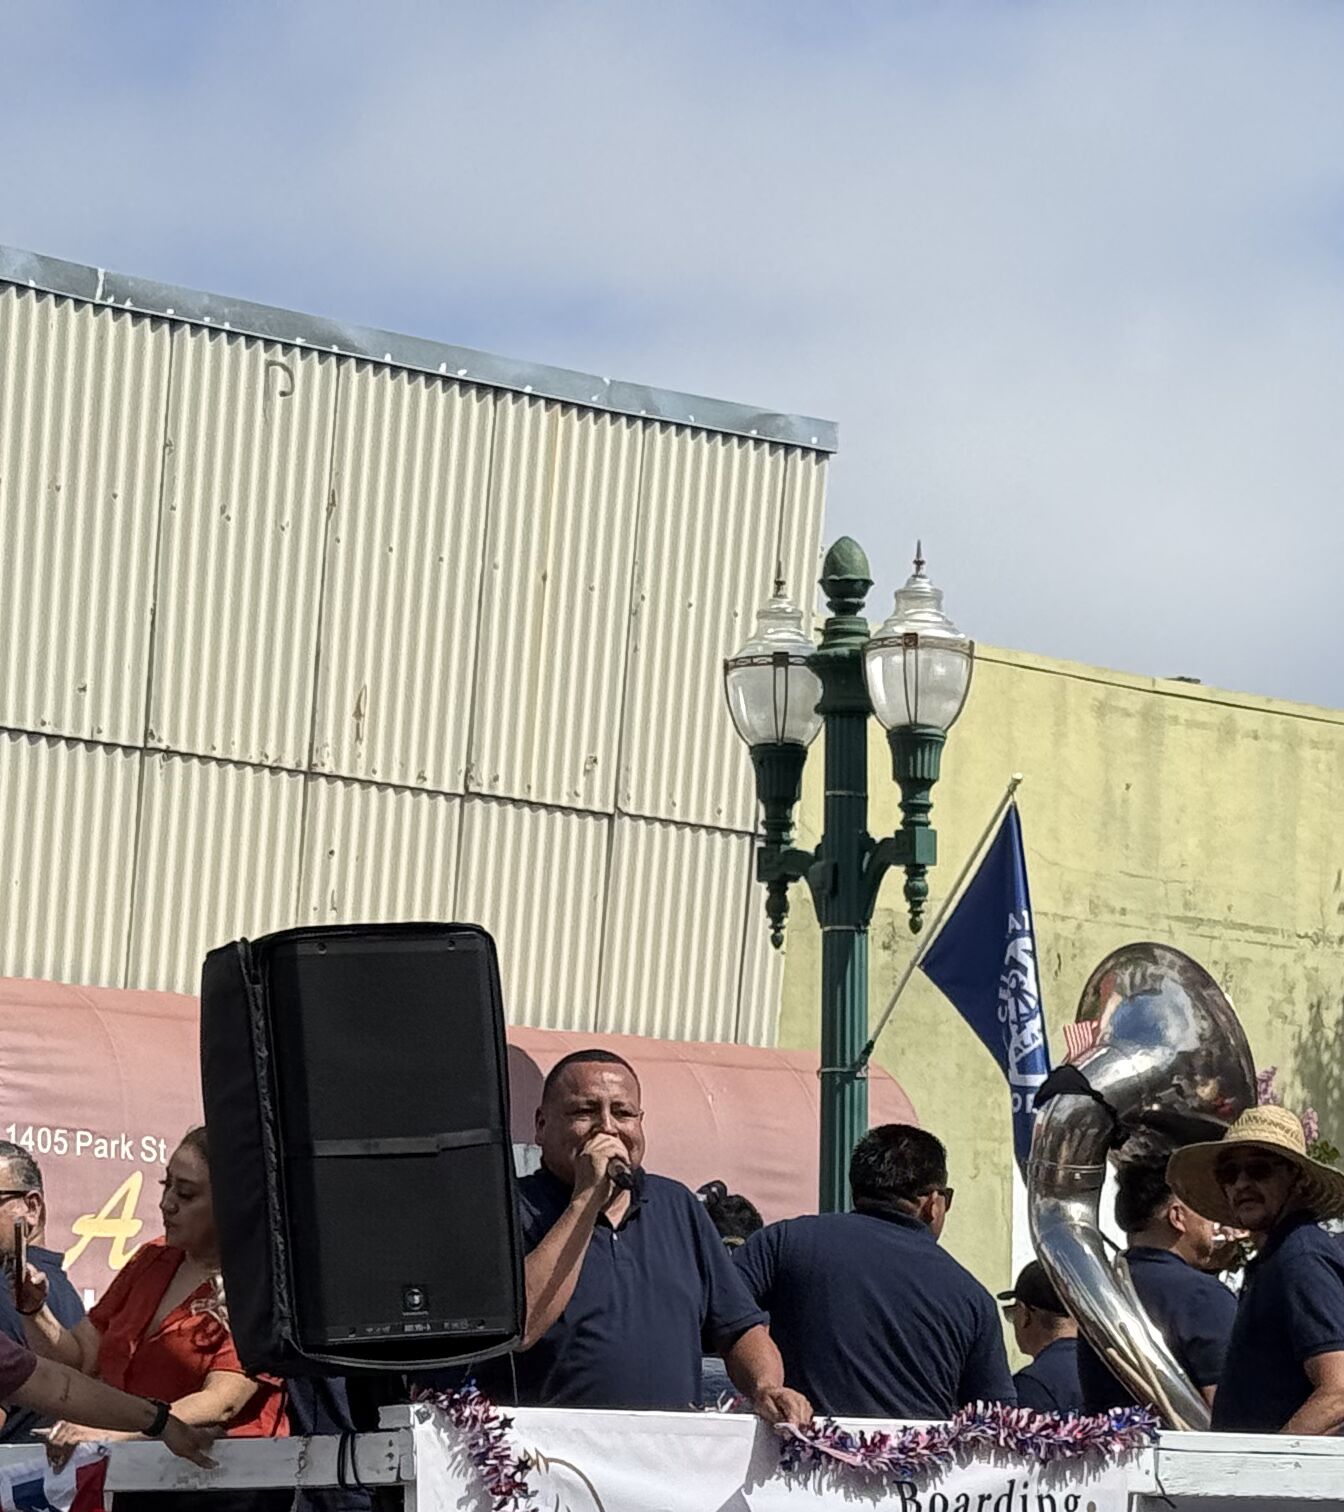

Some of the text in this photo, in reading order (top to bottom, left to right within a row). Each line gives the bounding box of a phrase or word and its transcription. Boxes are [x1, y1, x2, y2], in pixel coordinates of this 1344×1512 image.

[6, 1123, 168, 1164] 1405 Park St
